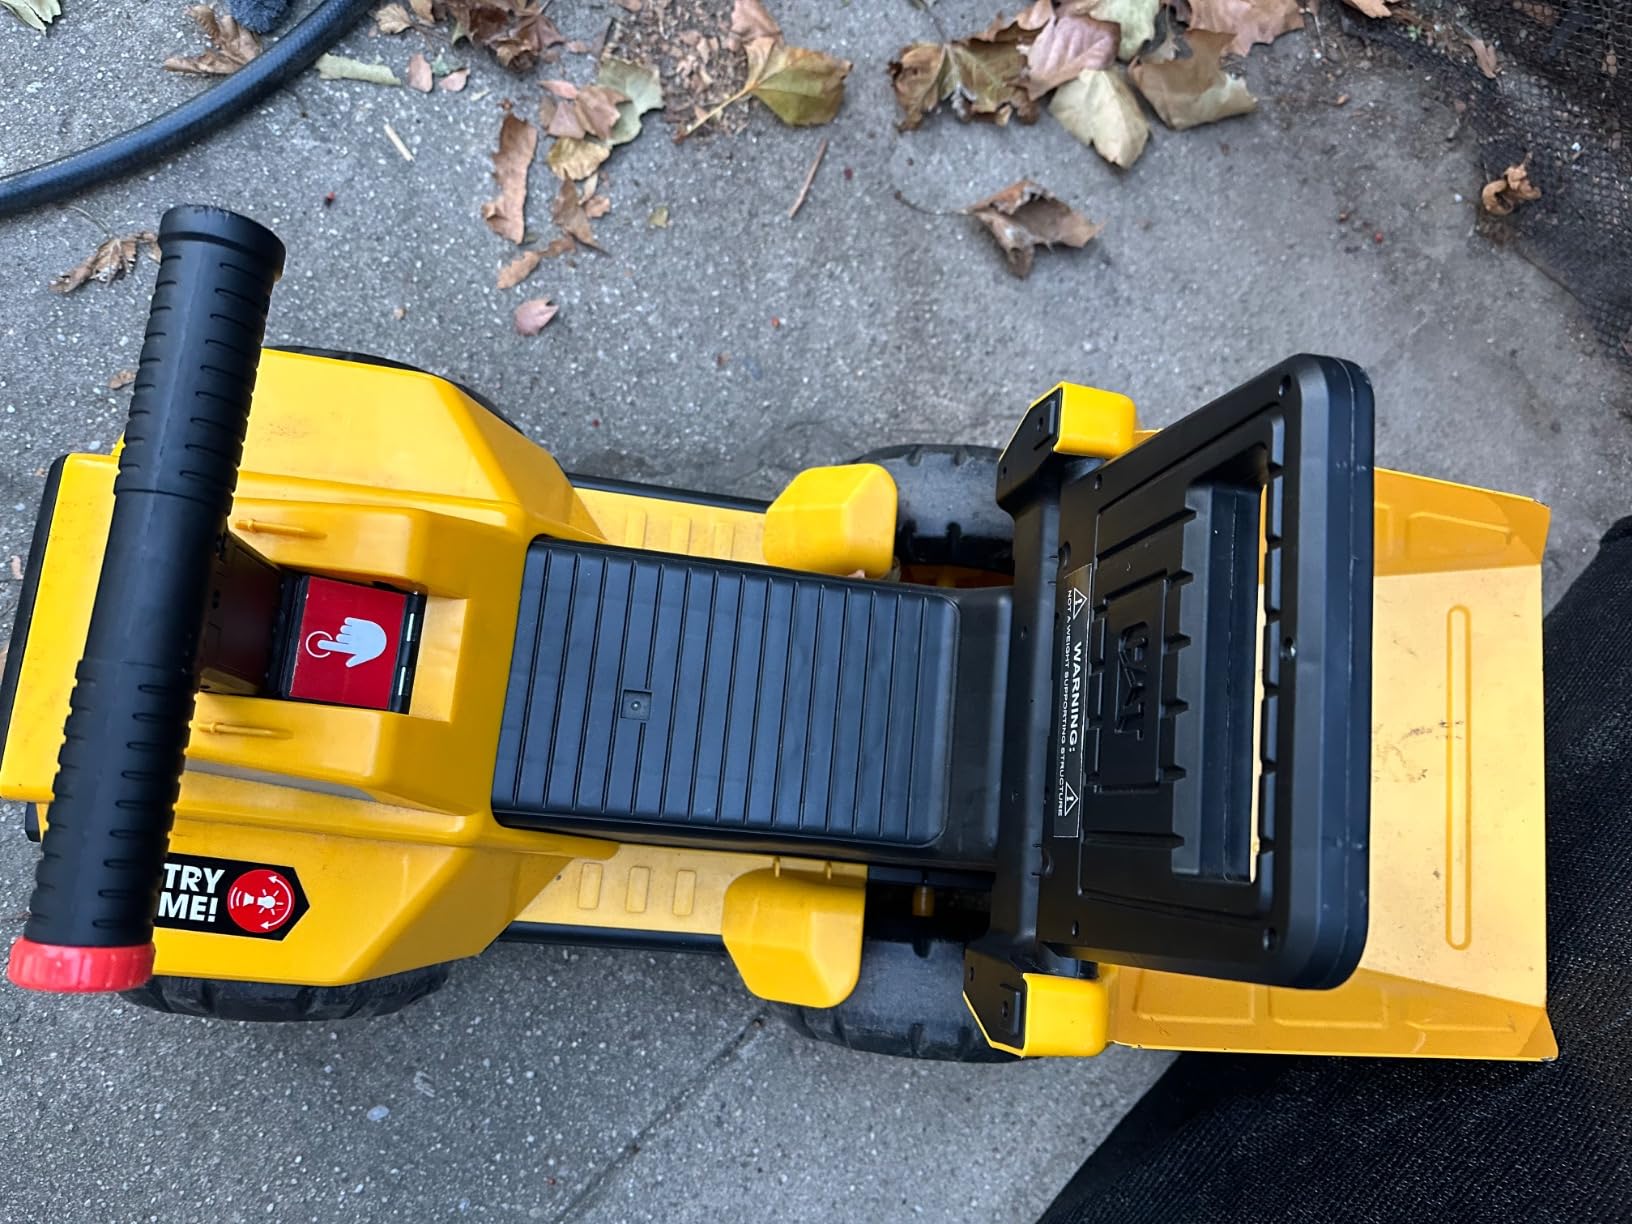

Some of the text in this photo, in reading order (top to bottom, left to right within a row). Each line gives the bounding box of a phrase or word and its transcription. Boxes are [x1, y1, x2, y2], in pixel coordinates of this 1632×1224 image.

[1061, 672, 1069, 745] SUPPORTING
[1069, 641, 1081, 753] WARNING:
[1057, 747, 1066, 817] STRUCTURE
[157, 891, 219, 922] ME!
[163, 862, 225, 894] TRY
